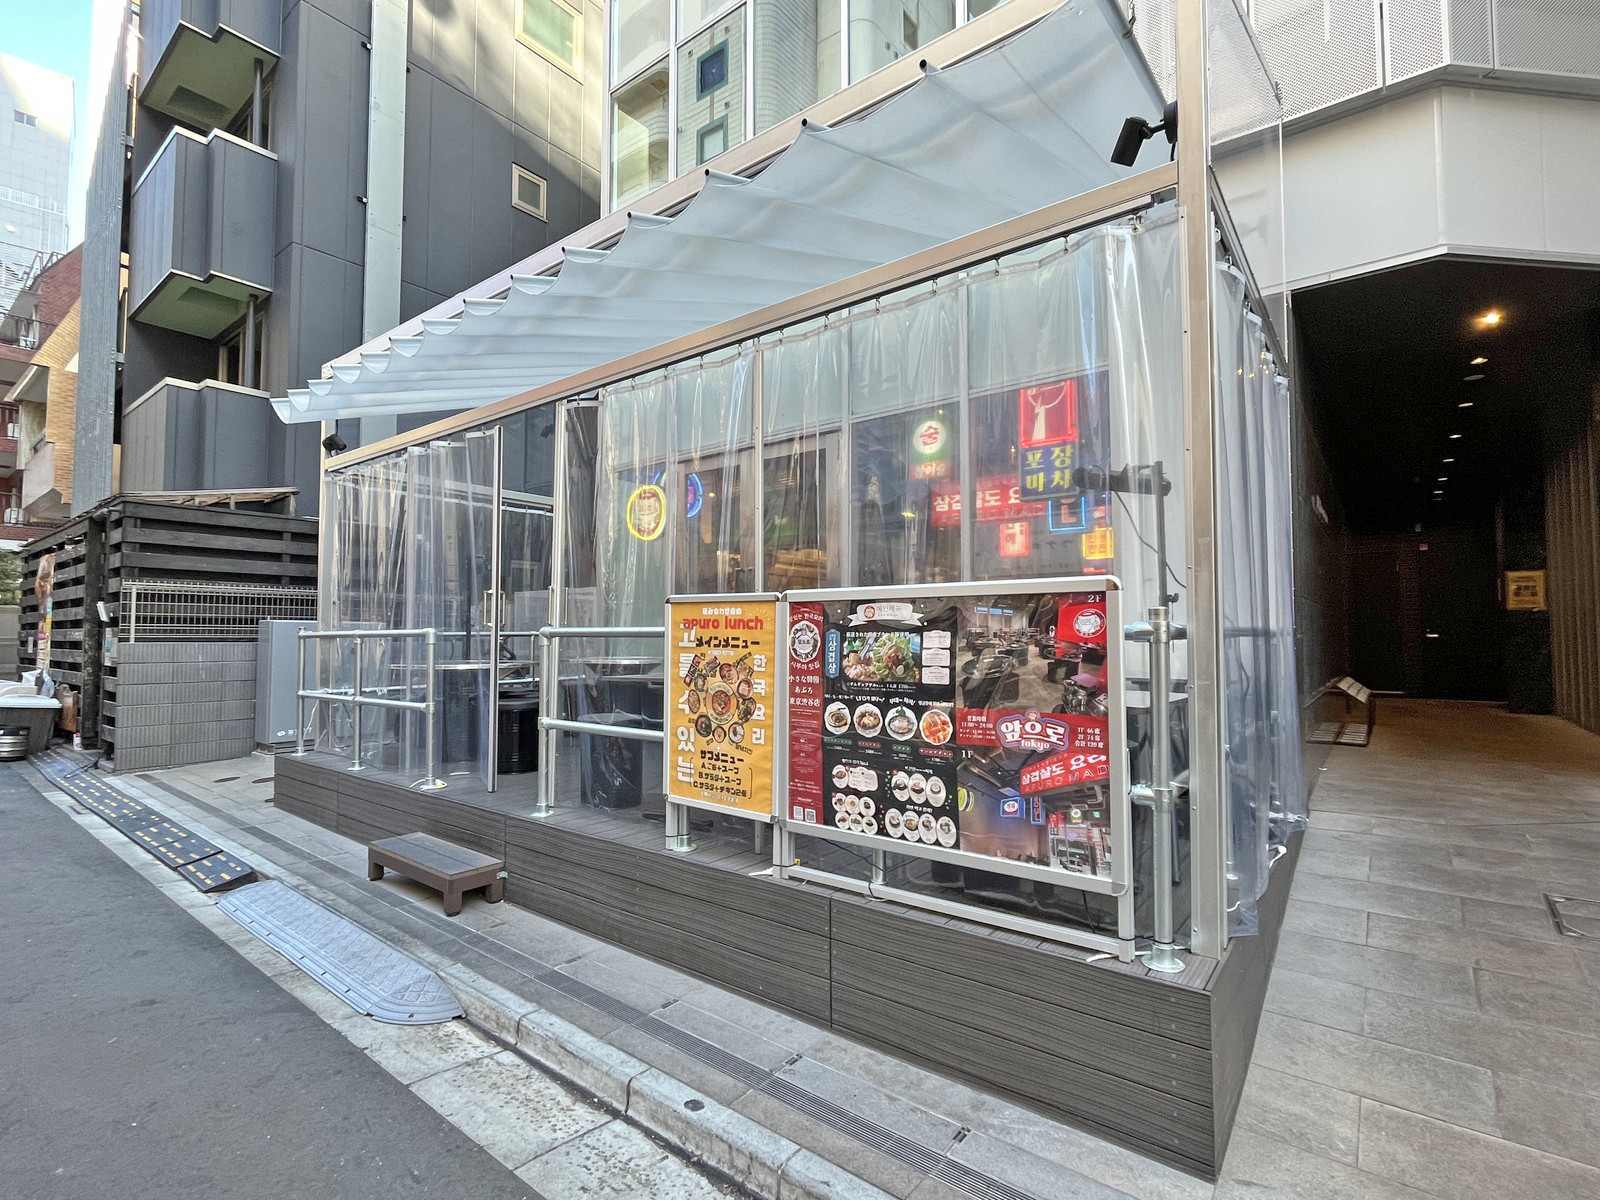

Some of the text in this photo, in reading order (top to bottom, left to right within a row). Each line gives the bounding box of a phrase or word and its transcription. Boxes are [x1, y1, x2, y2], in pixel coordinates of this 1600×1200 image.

[1024, 444, 1074, 469] 포장
[1025, 468, 1072, 492] 마차
[1088, 594, 1102, 603] 2F
[683, 615, 764, 631] apuro lunch
[695, 635, 761, 649] メインメニュー
[827, 640, 838, 674] 삼겹살
[1000, 720, 1065, 746] 앞으로
[1020, 739, 1050, 752] tokyo
[1021, 762, 1066, 785] 삼겹살도
